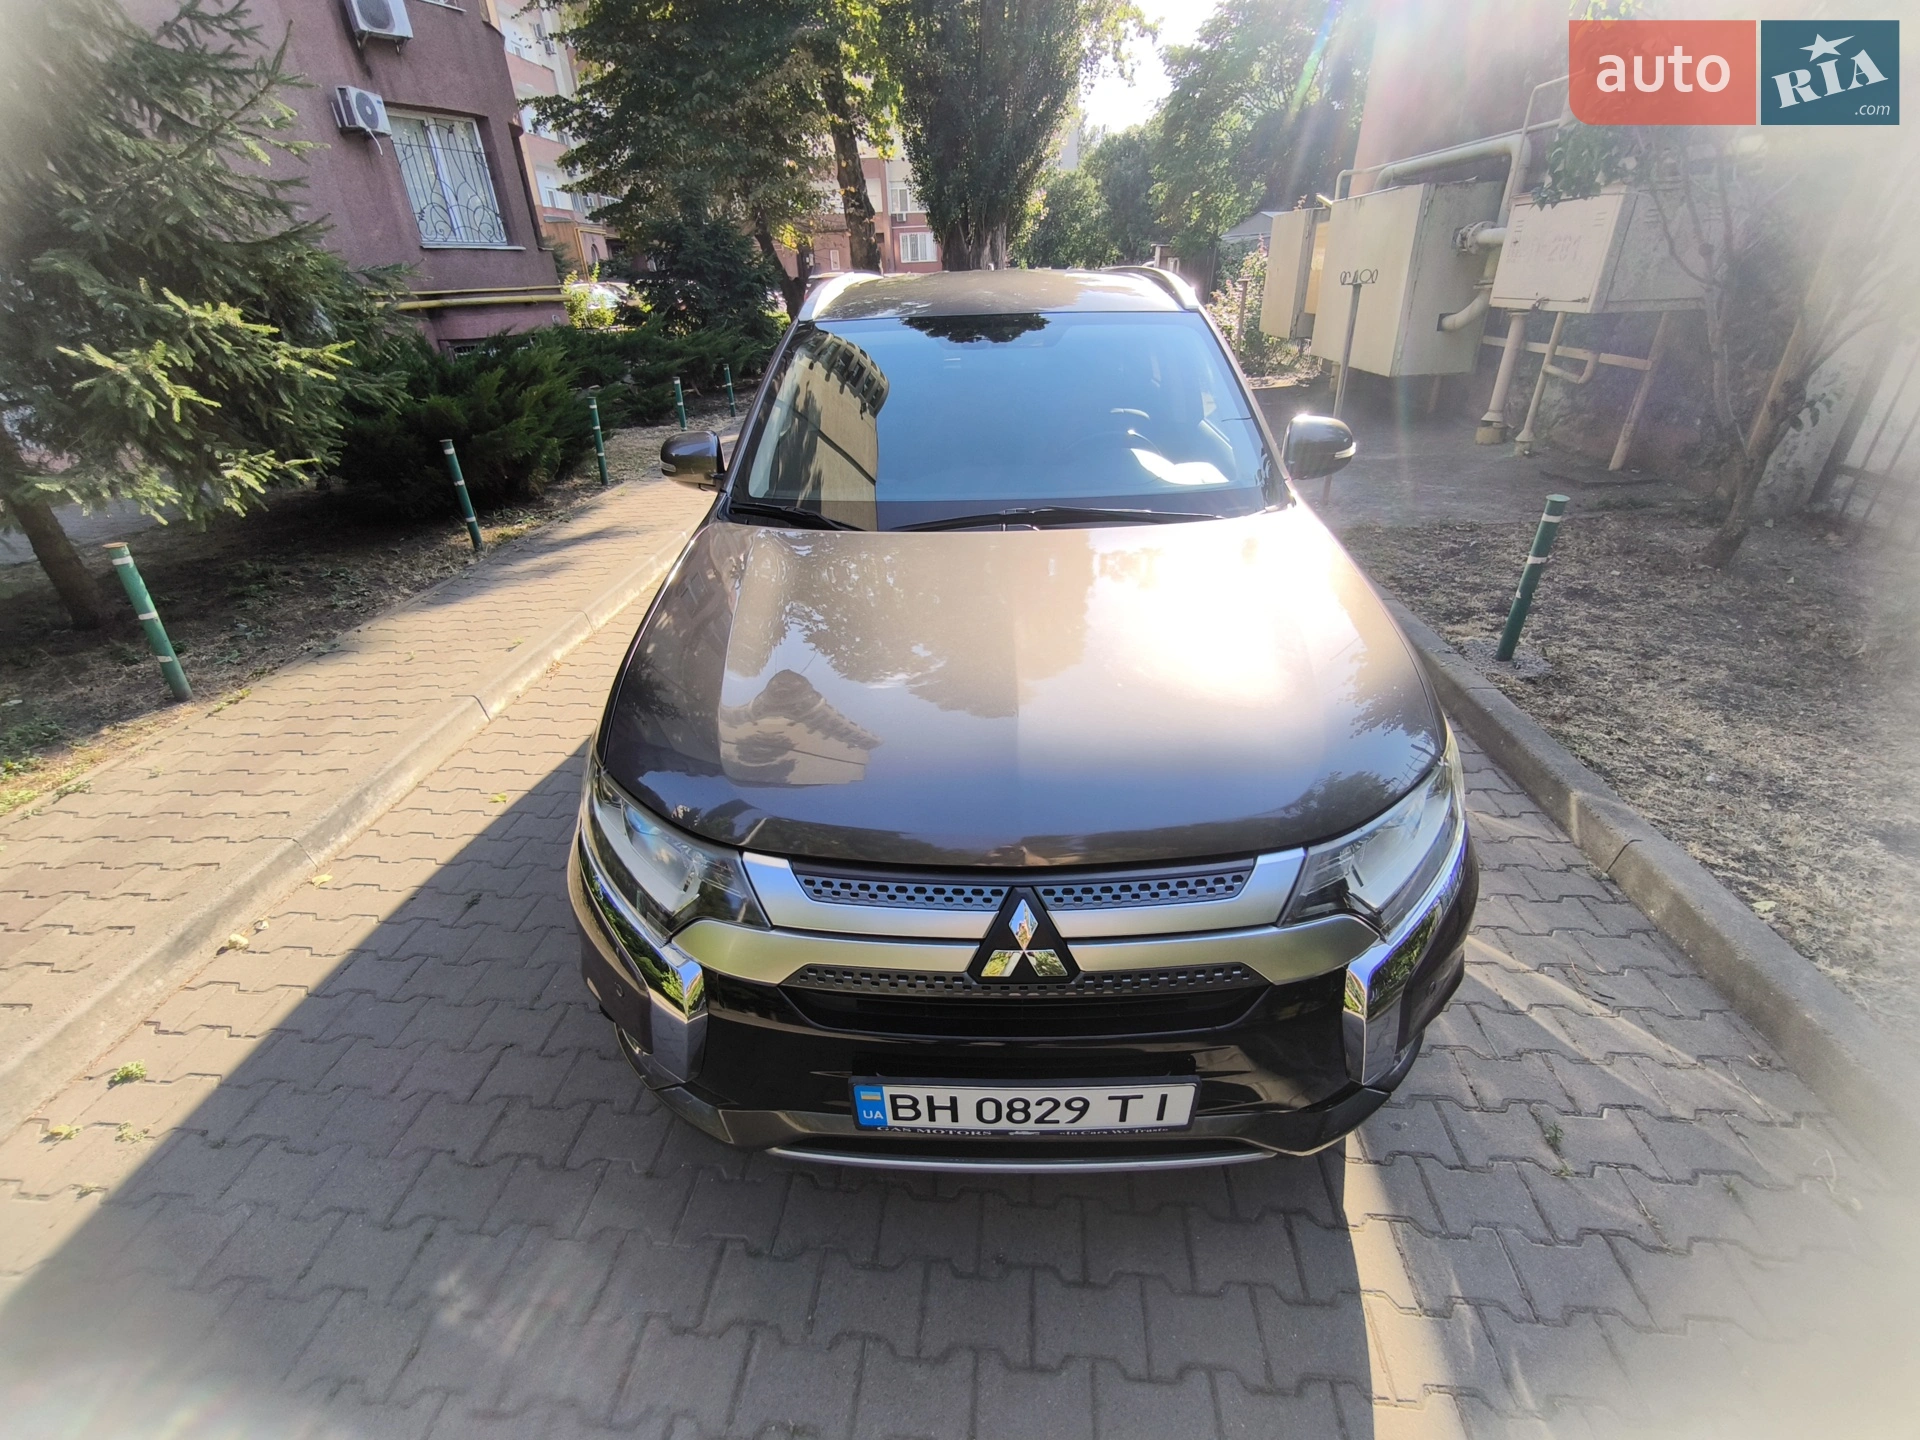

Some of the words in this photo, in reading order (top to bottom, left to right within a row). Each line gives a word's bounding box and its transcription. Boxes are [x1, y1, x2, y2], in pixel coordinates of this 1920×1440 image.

[862, 1109, 884, 1120] UA
[888, 1093, 959, 1123] BH
[975, 1096, 1091, 1125] 0829
[916, 1127, 992, 1136] MOTORS
